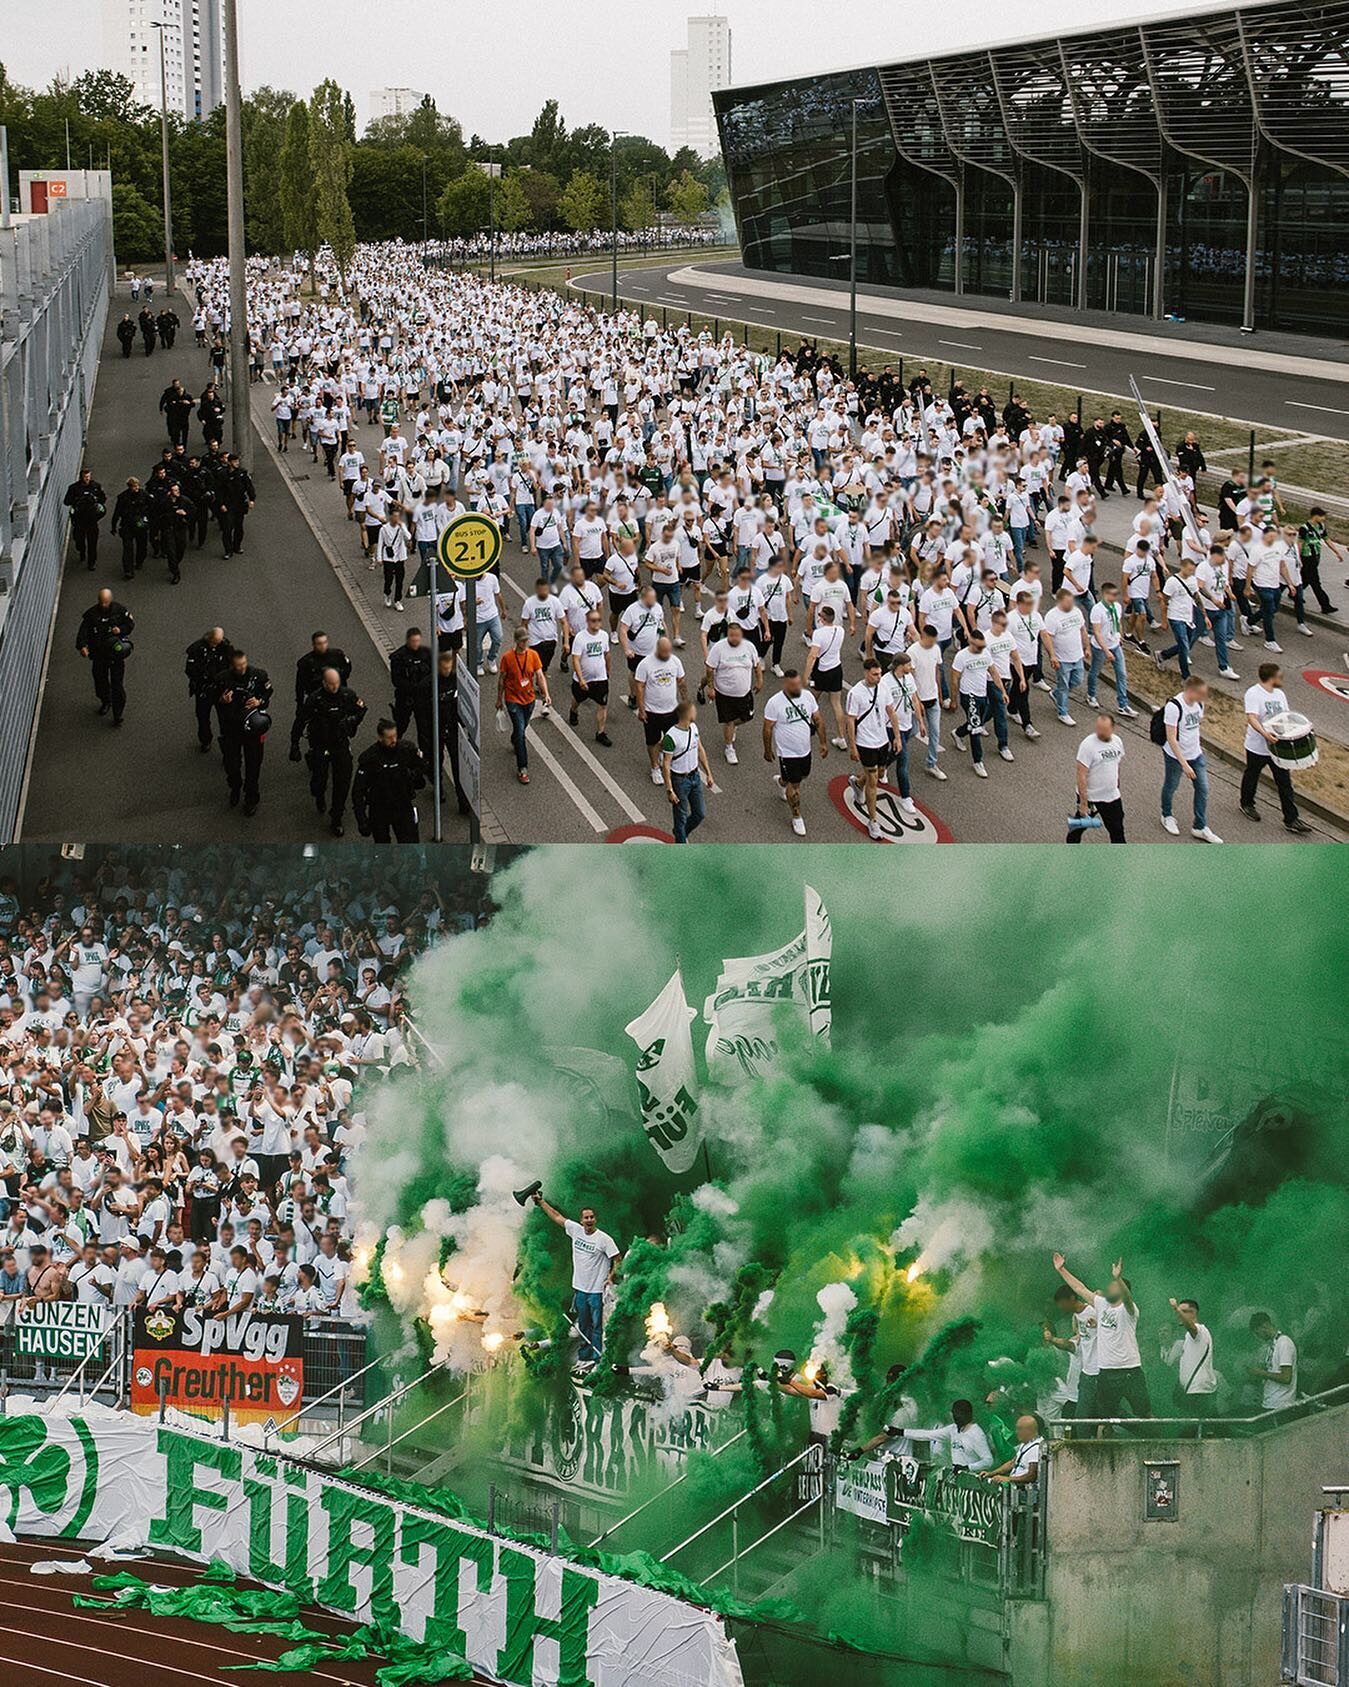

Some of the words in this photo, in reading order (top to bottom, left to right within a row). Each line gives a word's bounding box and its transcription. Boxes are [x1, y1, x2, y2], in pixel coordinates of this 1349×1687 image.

[51, 184, 65, 194] C2
[455, 530, 469, 538] BUS
[469, 528, 487, 537] STOP
[454, 539, 486, 563] 2.1
[20, 1301, 101, 1329] GUNZEN
[19, 1328, 100, 1358] HAUSEN
[181, 1307, 290, 1364] SpVgg
[154, 1357, 278, 1403] Greuther
[149, 1428, 600, 1687] FÜRTH
